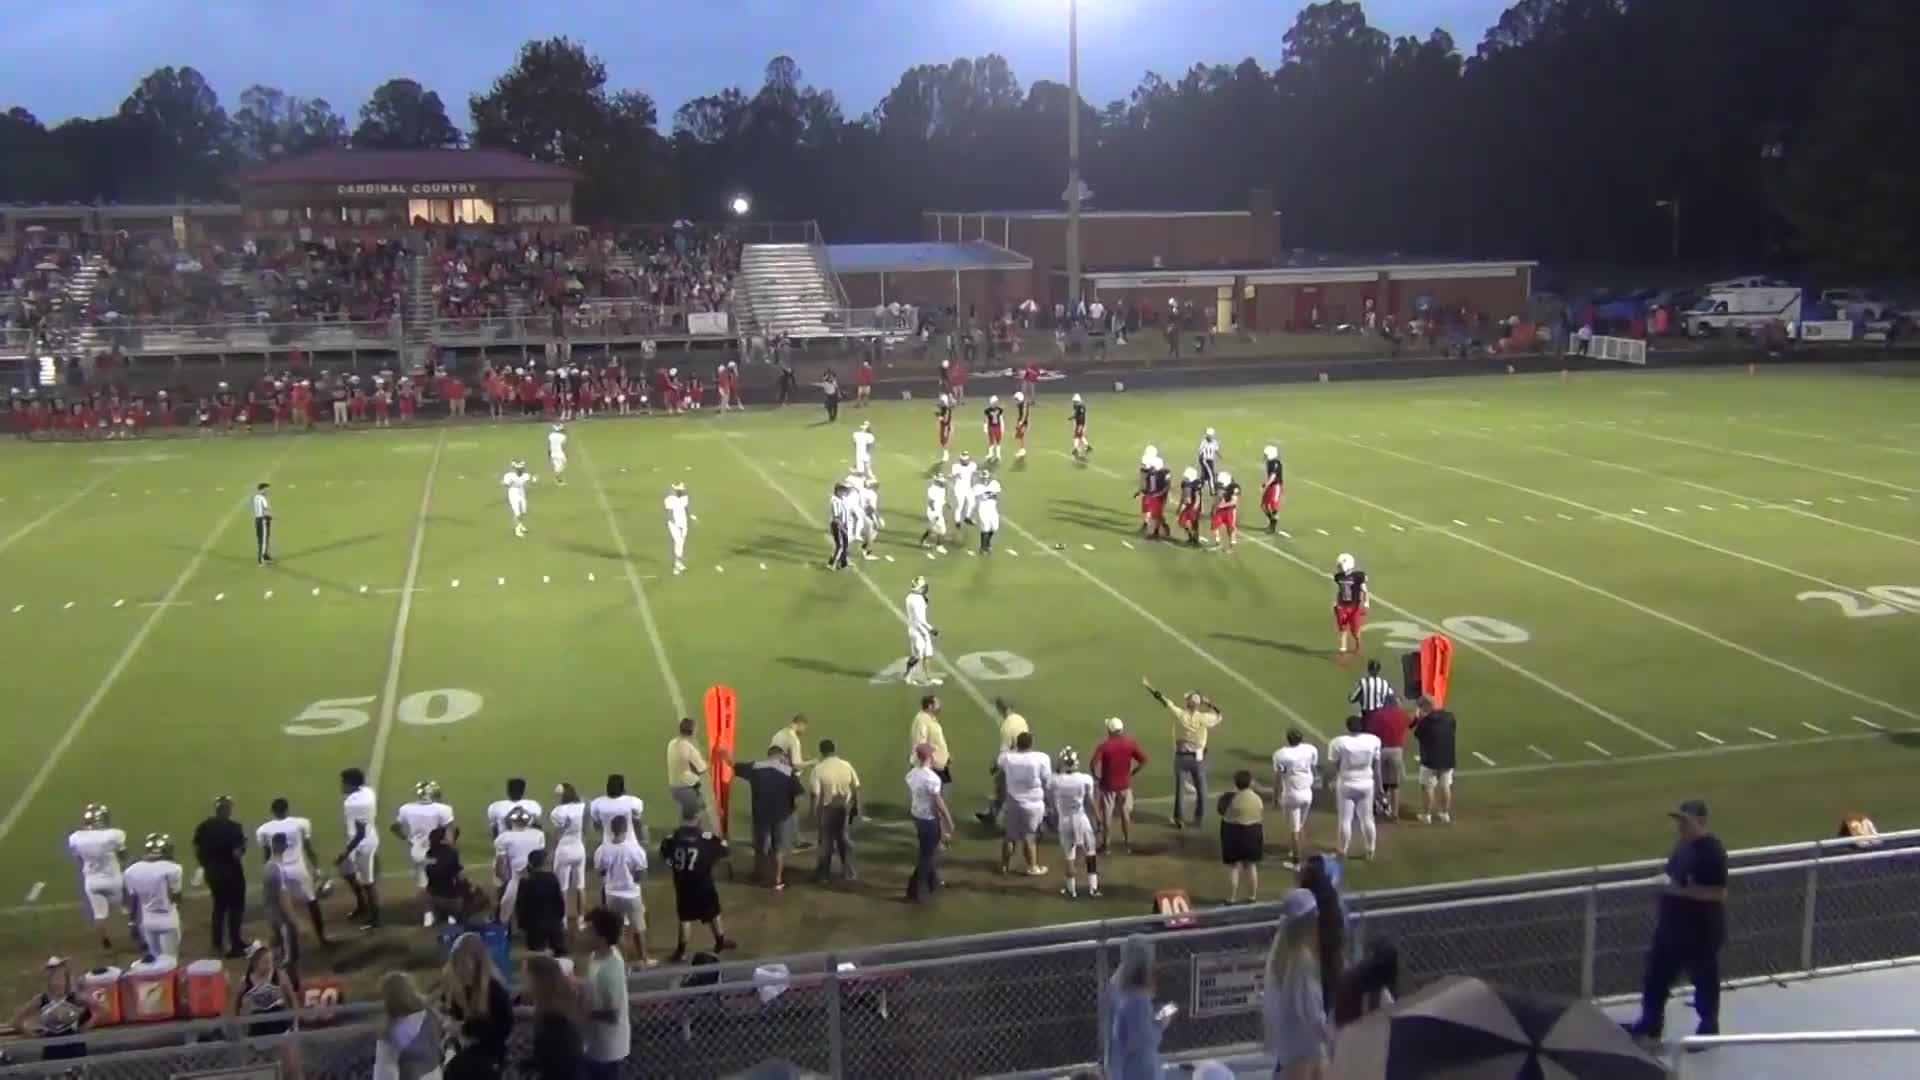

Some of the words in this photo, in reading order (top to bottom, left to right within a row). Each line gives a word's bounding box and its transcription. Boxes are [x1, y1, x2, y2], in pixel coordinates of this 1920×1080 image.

[337, 184, 407, 194] CARDINAL
[412, 184, 477, 193] COUNTRY
[284, 688, 484, 736] 50
[674, 847, 698, 871] 97
